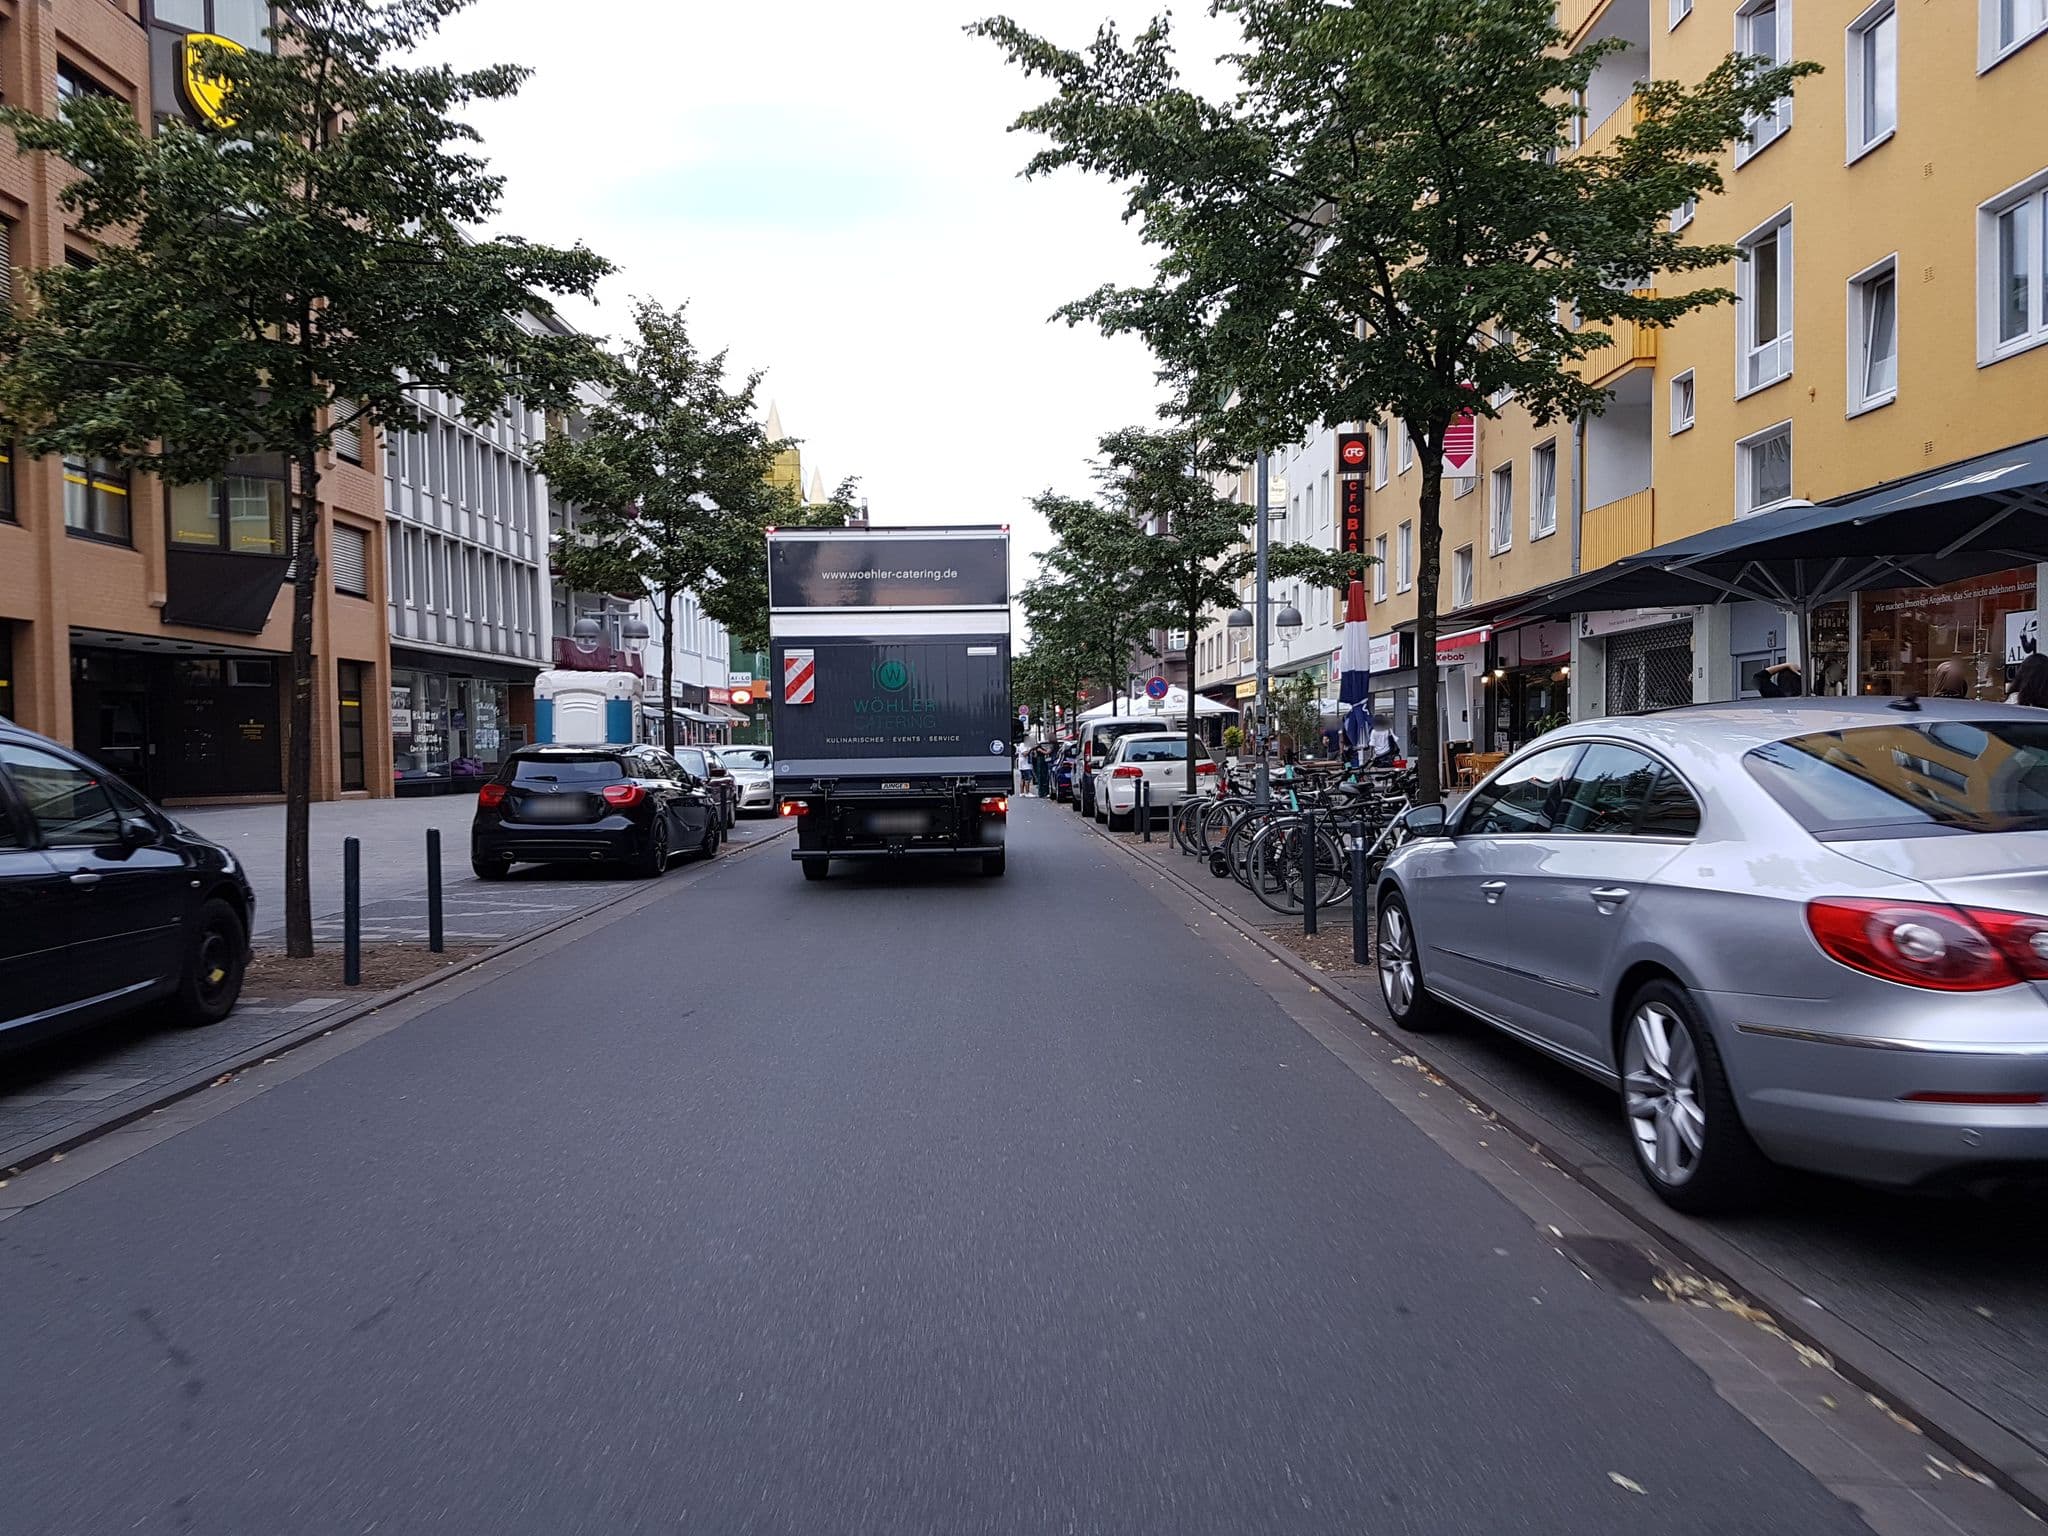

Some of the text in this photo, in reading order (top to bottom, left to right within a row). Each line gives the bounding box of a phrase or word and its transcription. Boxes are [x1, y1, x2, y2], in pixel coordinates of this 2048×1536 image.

[821, 568, 958, 580] www.woehler-catering.de
[1953, 591, 1963, 600] das
[1963, 589, 1973, 599] Sie
[1973, 587, 1987, 597] nicht
[1988, 584, 2016, 595] ablehnen
[1436, 653, 1465, 661] Kebab
[853, 696, 937, 713] WÖHLER
[854, 714, 937, 729] CATERING
[826, 736, 885, 744] KULINARISCHES
[892, 735, 921, 743] EVENTS
